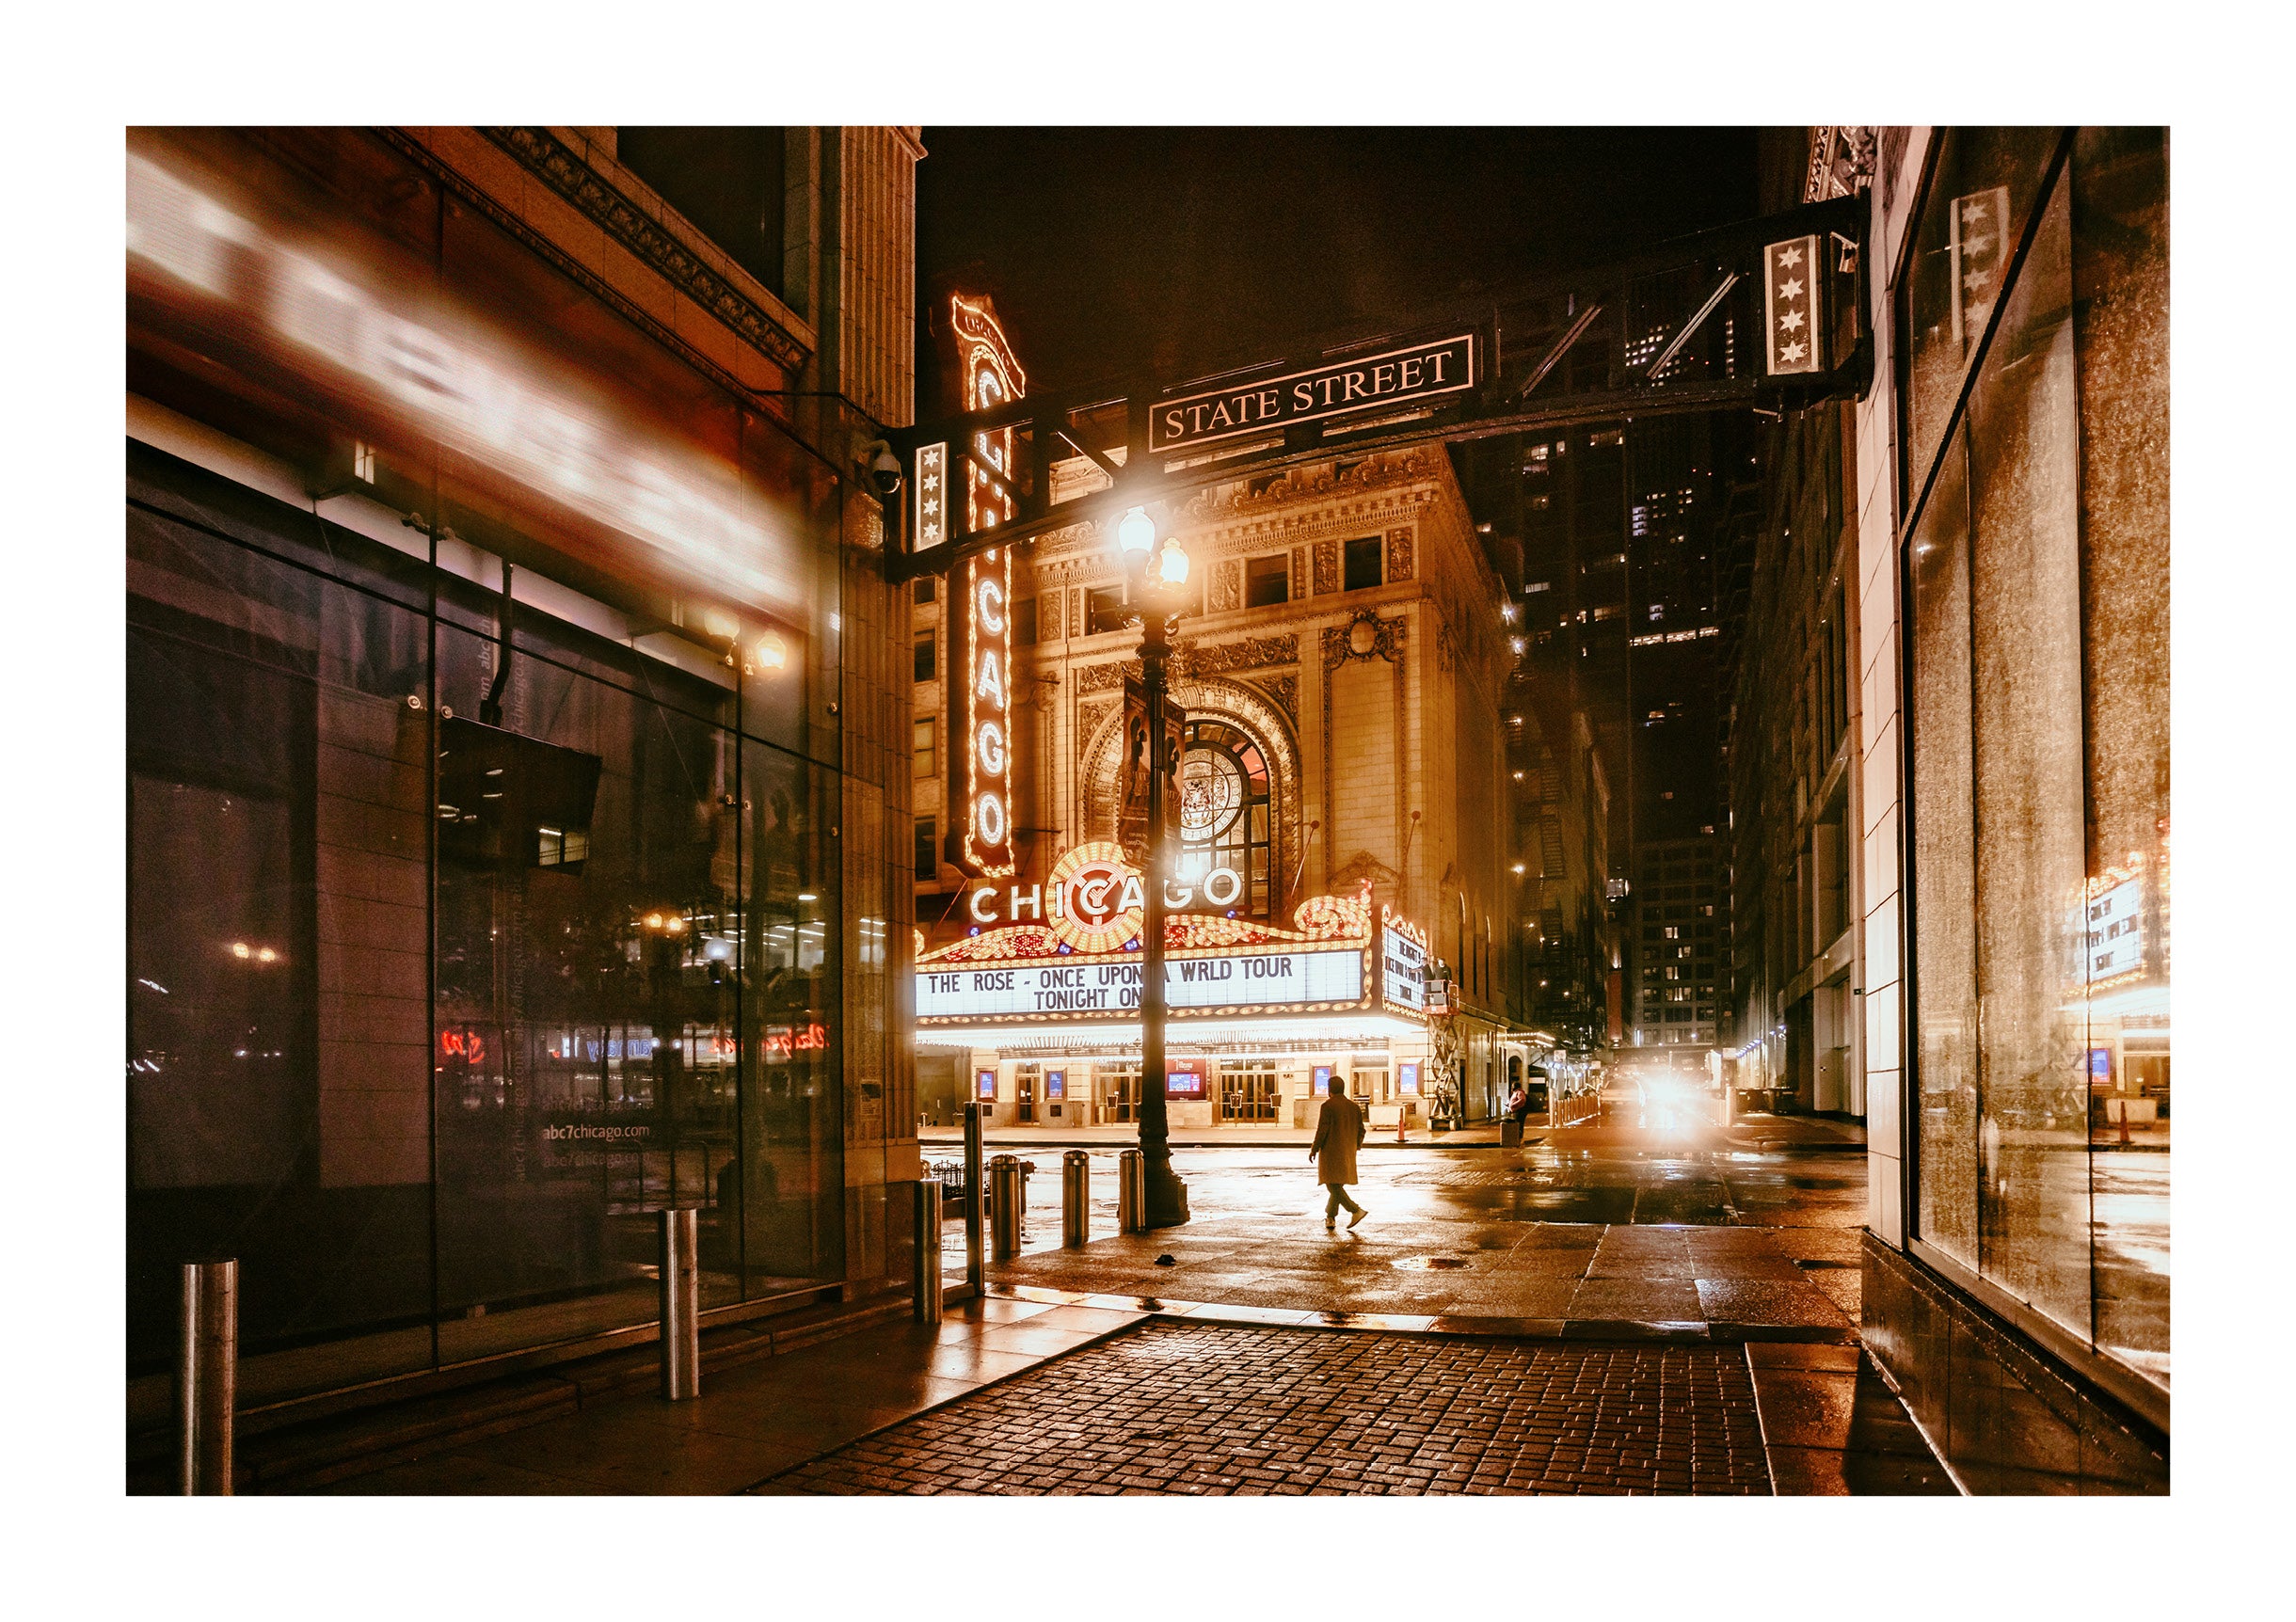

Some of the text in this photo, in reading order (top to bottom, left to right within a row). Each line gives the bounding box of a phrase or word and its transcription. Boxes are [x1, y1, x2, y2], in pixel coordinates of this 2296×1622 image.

[1165, 350, 1453, 439] STATE STREET
[970, 867, 1243, 923] CHICAGO
[928, 974, 961, 994] THE
[973, 971, 1015, 992] ROSE
[1040, 967, 1086, 989] ONCE
[1098, 964, 1144, 986] UPON
[1180, 960, 1233, 982] WRLD
[1240, 957, 1293, 979] TOUR
[1033, 988, 1109, 1010] TONIGHT
[542, 1123, 651, 1143] abc7chicago.com
